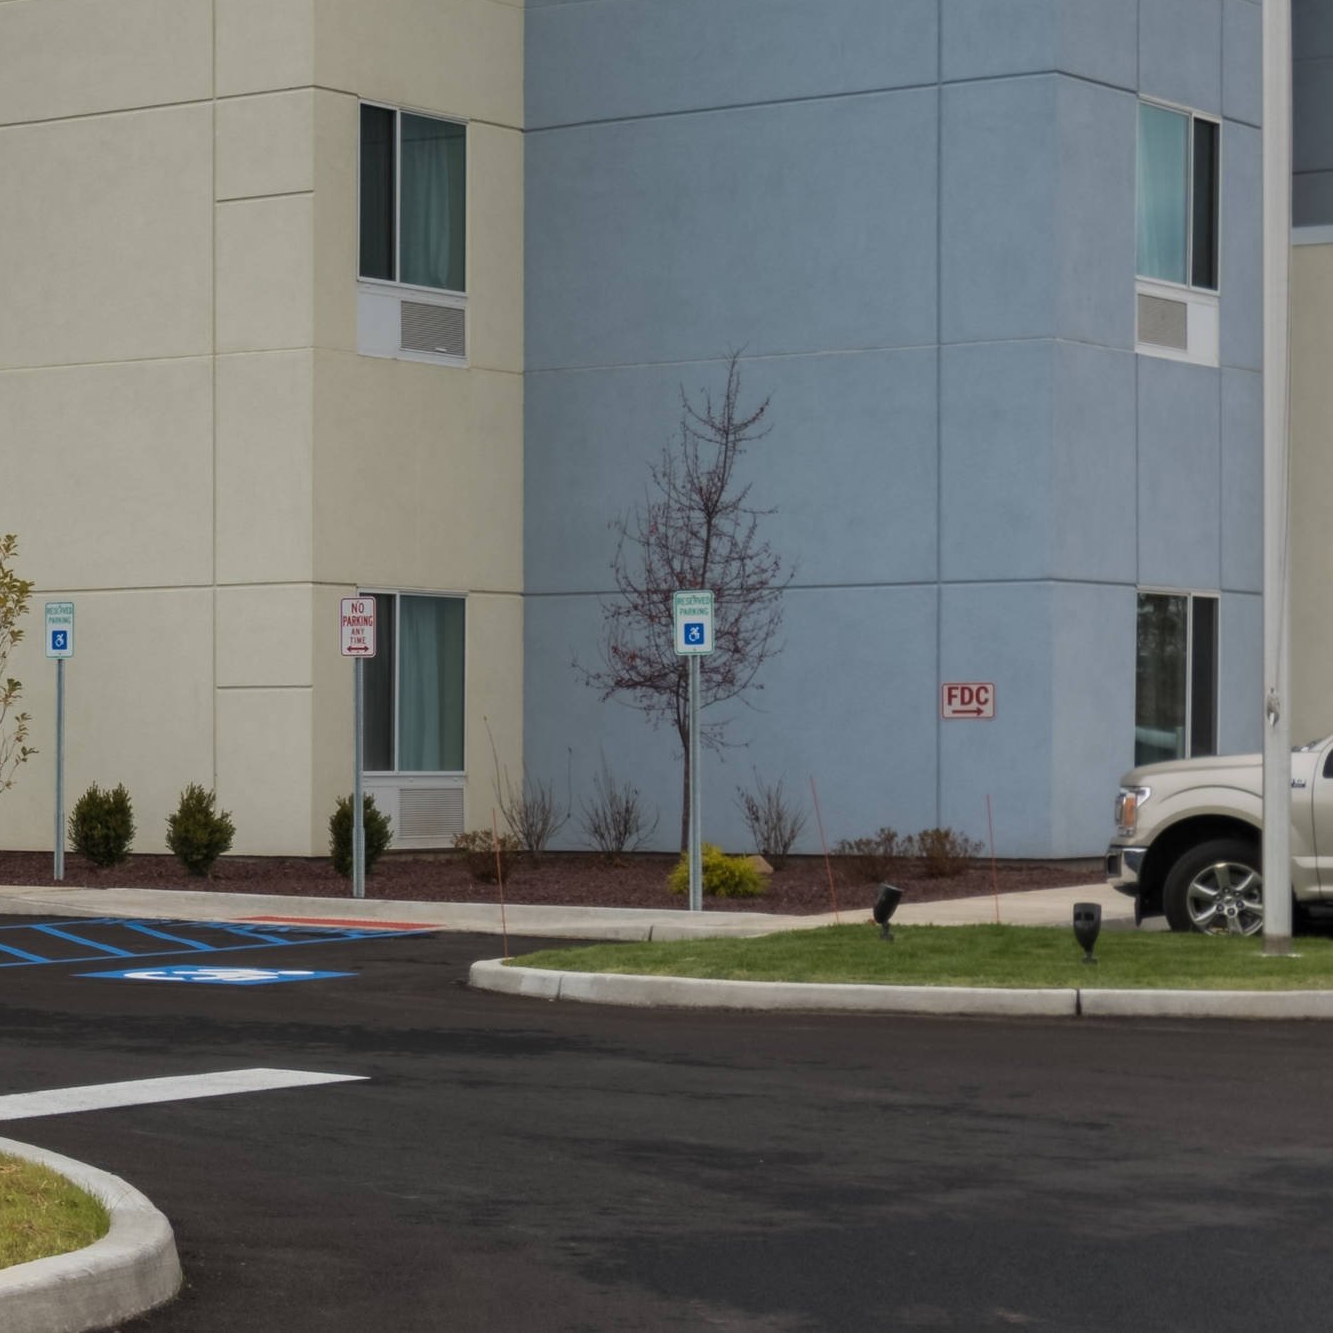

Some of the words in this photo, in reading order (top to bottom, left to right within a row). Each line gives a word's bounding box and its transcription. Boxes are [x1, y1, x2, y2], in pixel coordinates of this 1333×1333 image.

[676, 596, 711, 605] RESERVED
[351, 602, 365, 614] NO
[679, 607, 710, 616] PARKING
[48, 616, 72, 625] PARKING
[343, 615, 373, 626] PARKING
[351, 627, 365, 635] ANY
[350, 636, 366, 644] TIME
[947, 685, 989, 706] FDC
